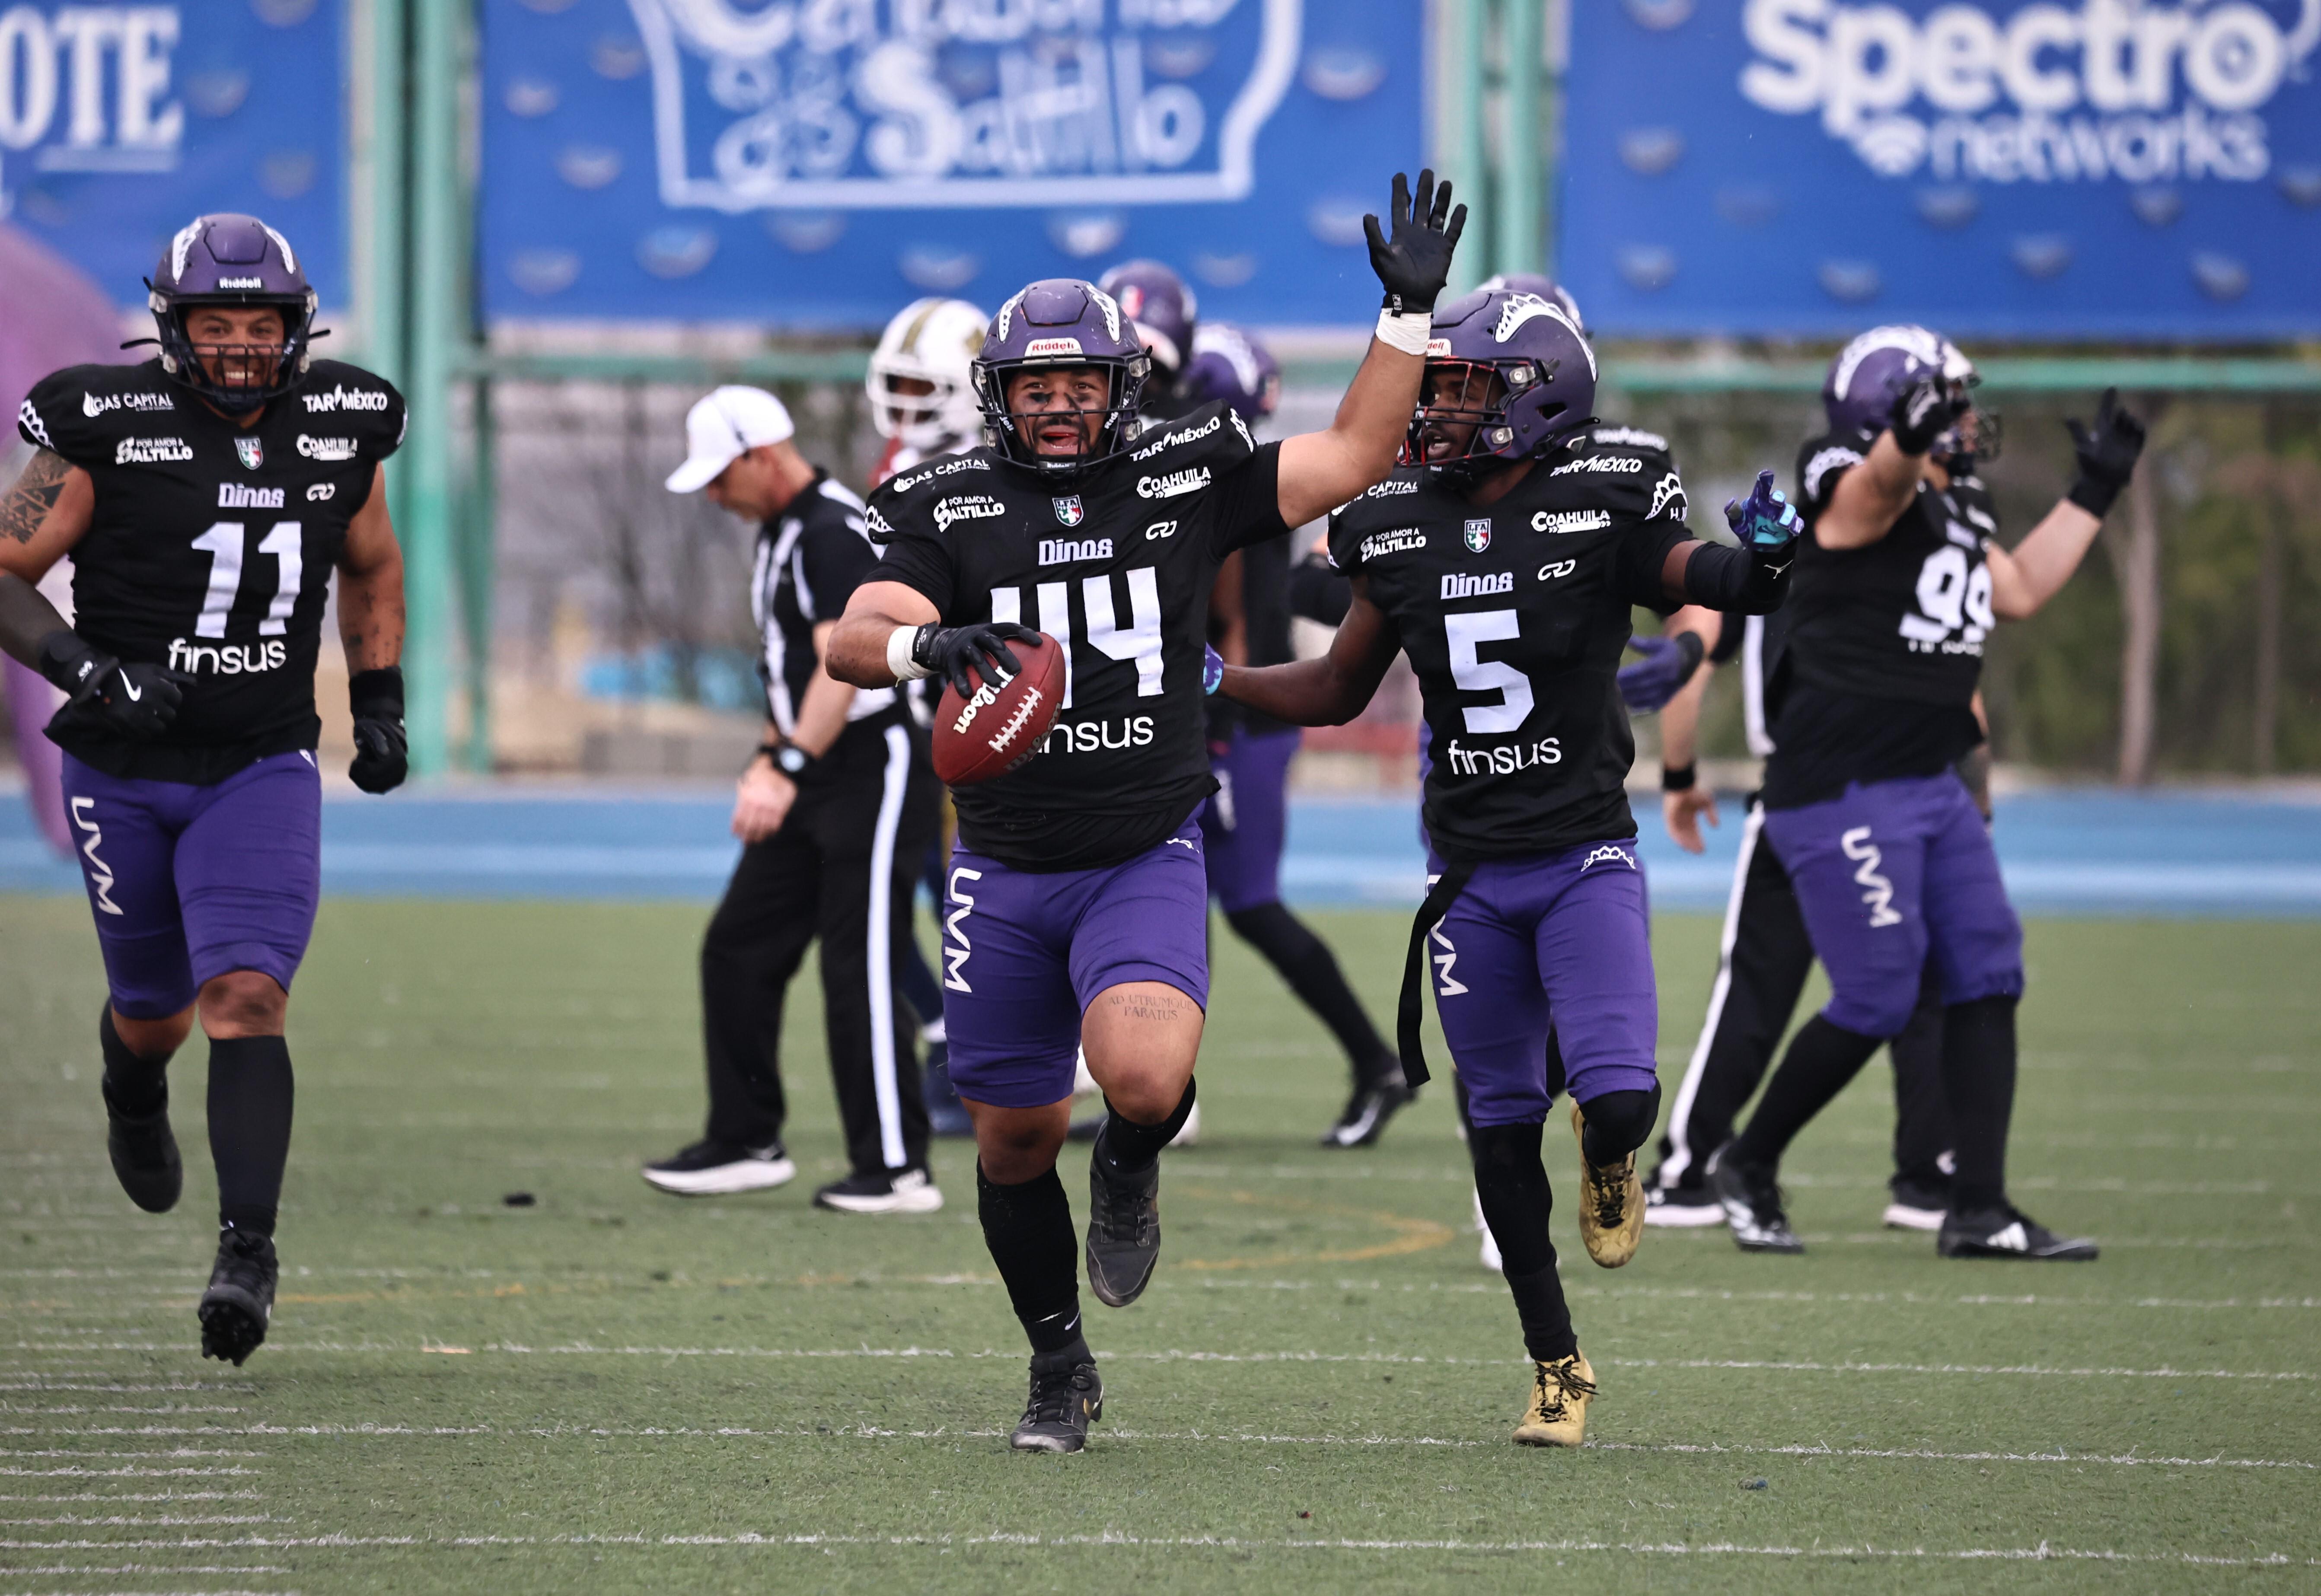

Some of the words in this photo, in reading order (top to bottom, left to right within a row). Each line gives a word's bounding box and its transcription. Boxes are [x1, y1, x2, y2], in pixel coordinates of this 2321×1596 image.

[1740, 0, 2284, 136] Spectro
[219, 277, 261, 289] Riddell
[93, 394, 121, 411] GAS
[123, 393, 173, 408] CAPITAL
[302, 393, 335, 413] TAR
[341, 387, 388, 411] MÉXICO
[136, 437, 153, 448] POR
[154, 437, 177, 447] AMOR
[178, 437, 184, 447] A
[296, 433, 358, 457] COAHUILA
[1129, 441, 1164, 462] TAR
[1170, 416, 1221, 446] MÉXICO
[905, 471, 933, 486] GAS
[935, 459, 989, 475] CAPITAL
[1587, 456, 1642, 472] MÉXICO
[218, 482, 285, 508] Dinos
[1137, 466, 1211, 498] COAHUILA
[1368, 481, 1418, 496] CAPITAL
[933, 498, 1005, 532] SALTILLO
[949, 497, 963, 507] POR
[964, 496, 986, 505] AMOR
[1531, 510, 1611, 532] COAHUILA
[1376, 532, 1390, 542] POR
[1391, 528, 1412, 540] AMOR
[1039, 538, 1113, 566] Dinos
[1361, 535, 1426, 563] SALTILLO
[191, 521, 303, 639] 11
[1441, 572, 1513, 600] Dinos
[169, 637, 286, 674] finsus
[1444, 609, 1535, 733] 5
[1038, 716, 1154, 753] nsus
[1448, 737, 1562, 774] finsus
[945, 867, 982, 993] UVM
[1125, 1006, 1178, 1020] PARATUS
